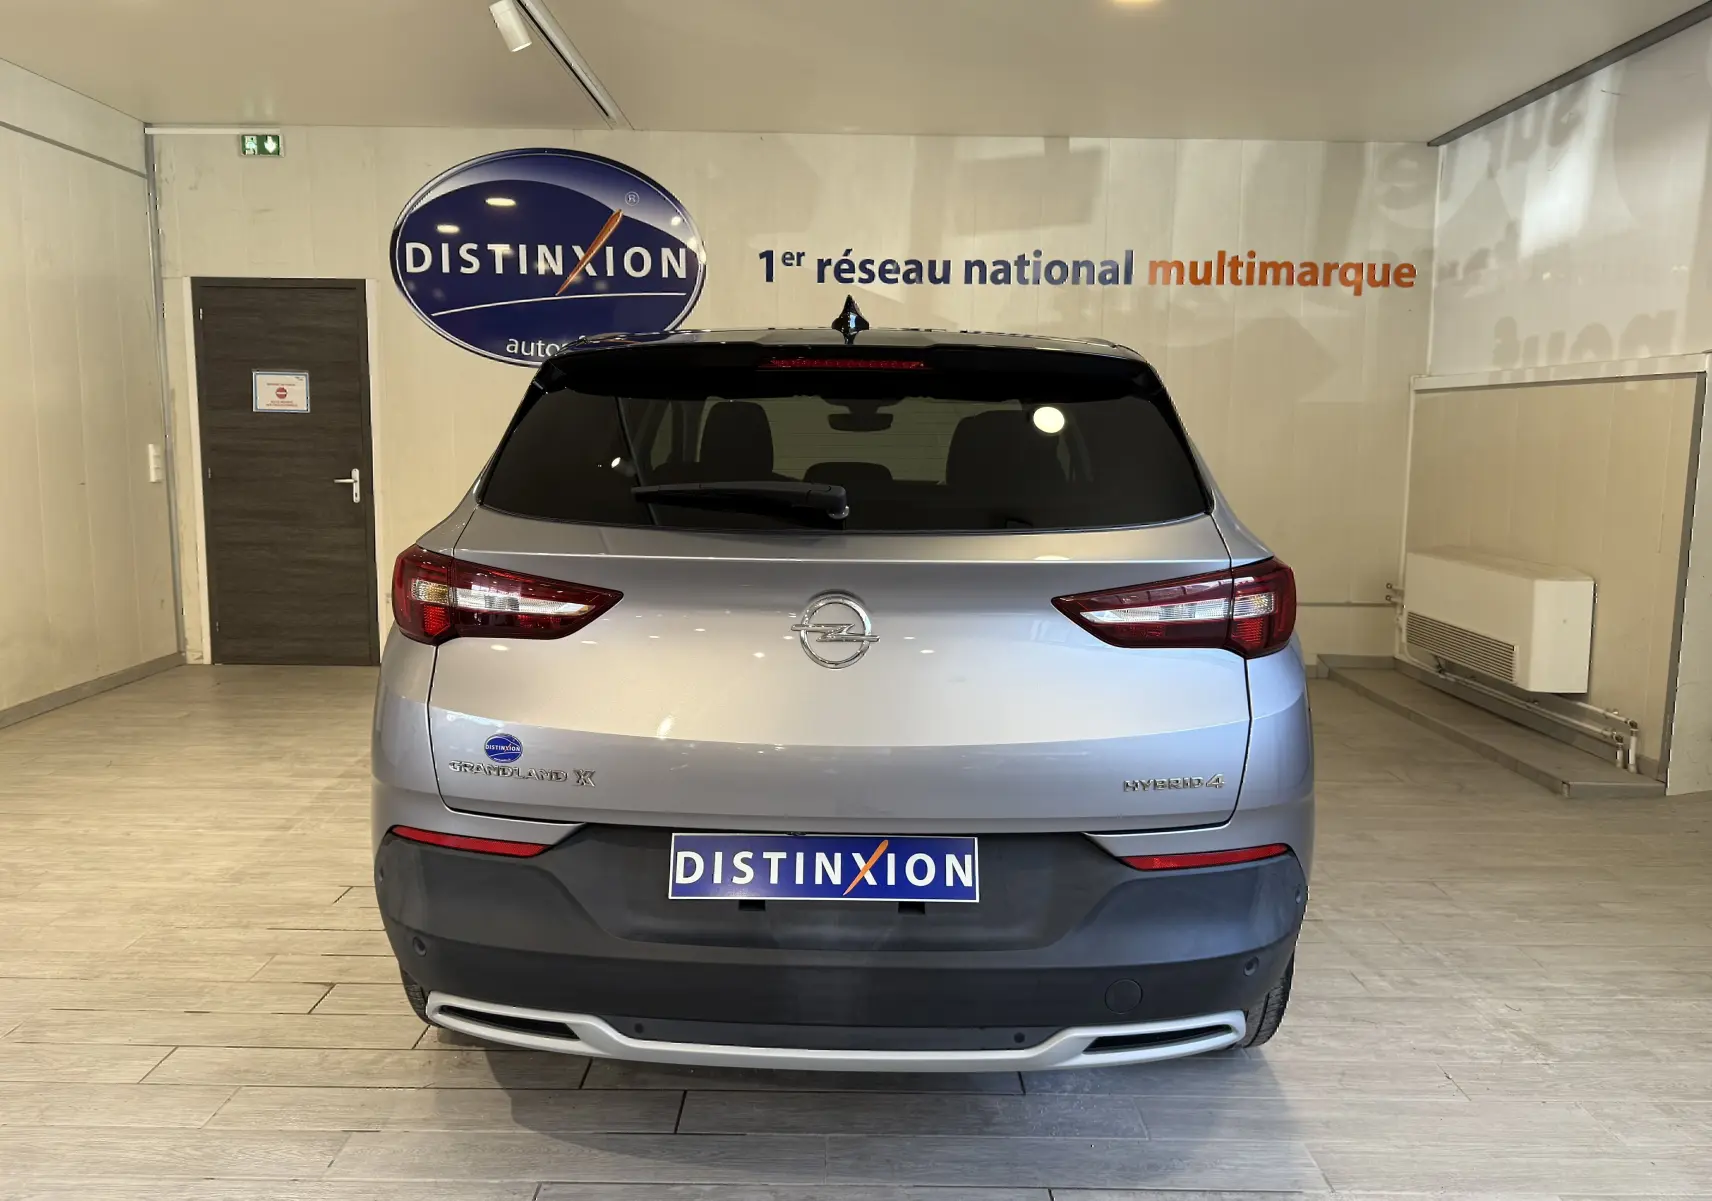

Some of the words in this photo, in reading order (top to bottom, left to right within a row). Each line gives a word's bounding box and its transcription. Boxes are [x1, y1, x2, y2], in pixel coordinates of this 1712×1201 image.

[758, 249, 806, 283] 1er
[816, 248, 952, 285] réseau
[964, 247, 1134, 286] national
[1149, 250, 1418, 296] multimarque
[485, 743, 521, 753] DISTINXION
[449, 760, 568, 782] GRANDLAND
[572, 768, 596, 787] X
[675, 839, 973, 896] DISTINXION
